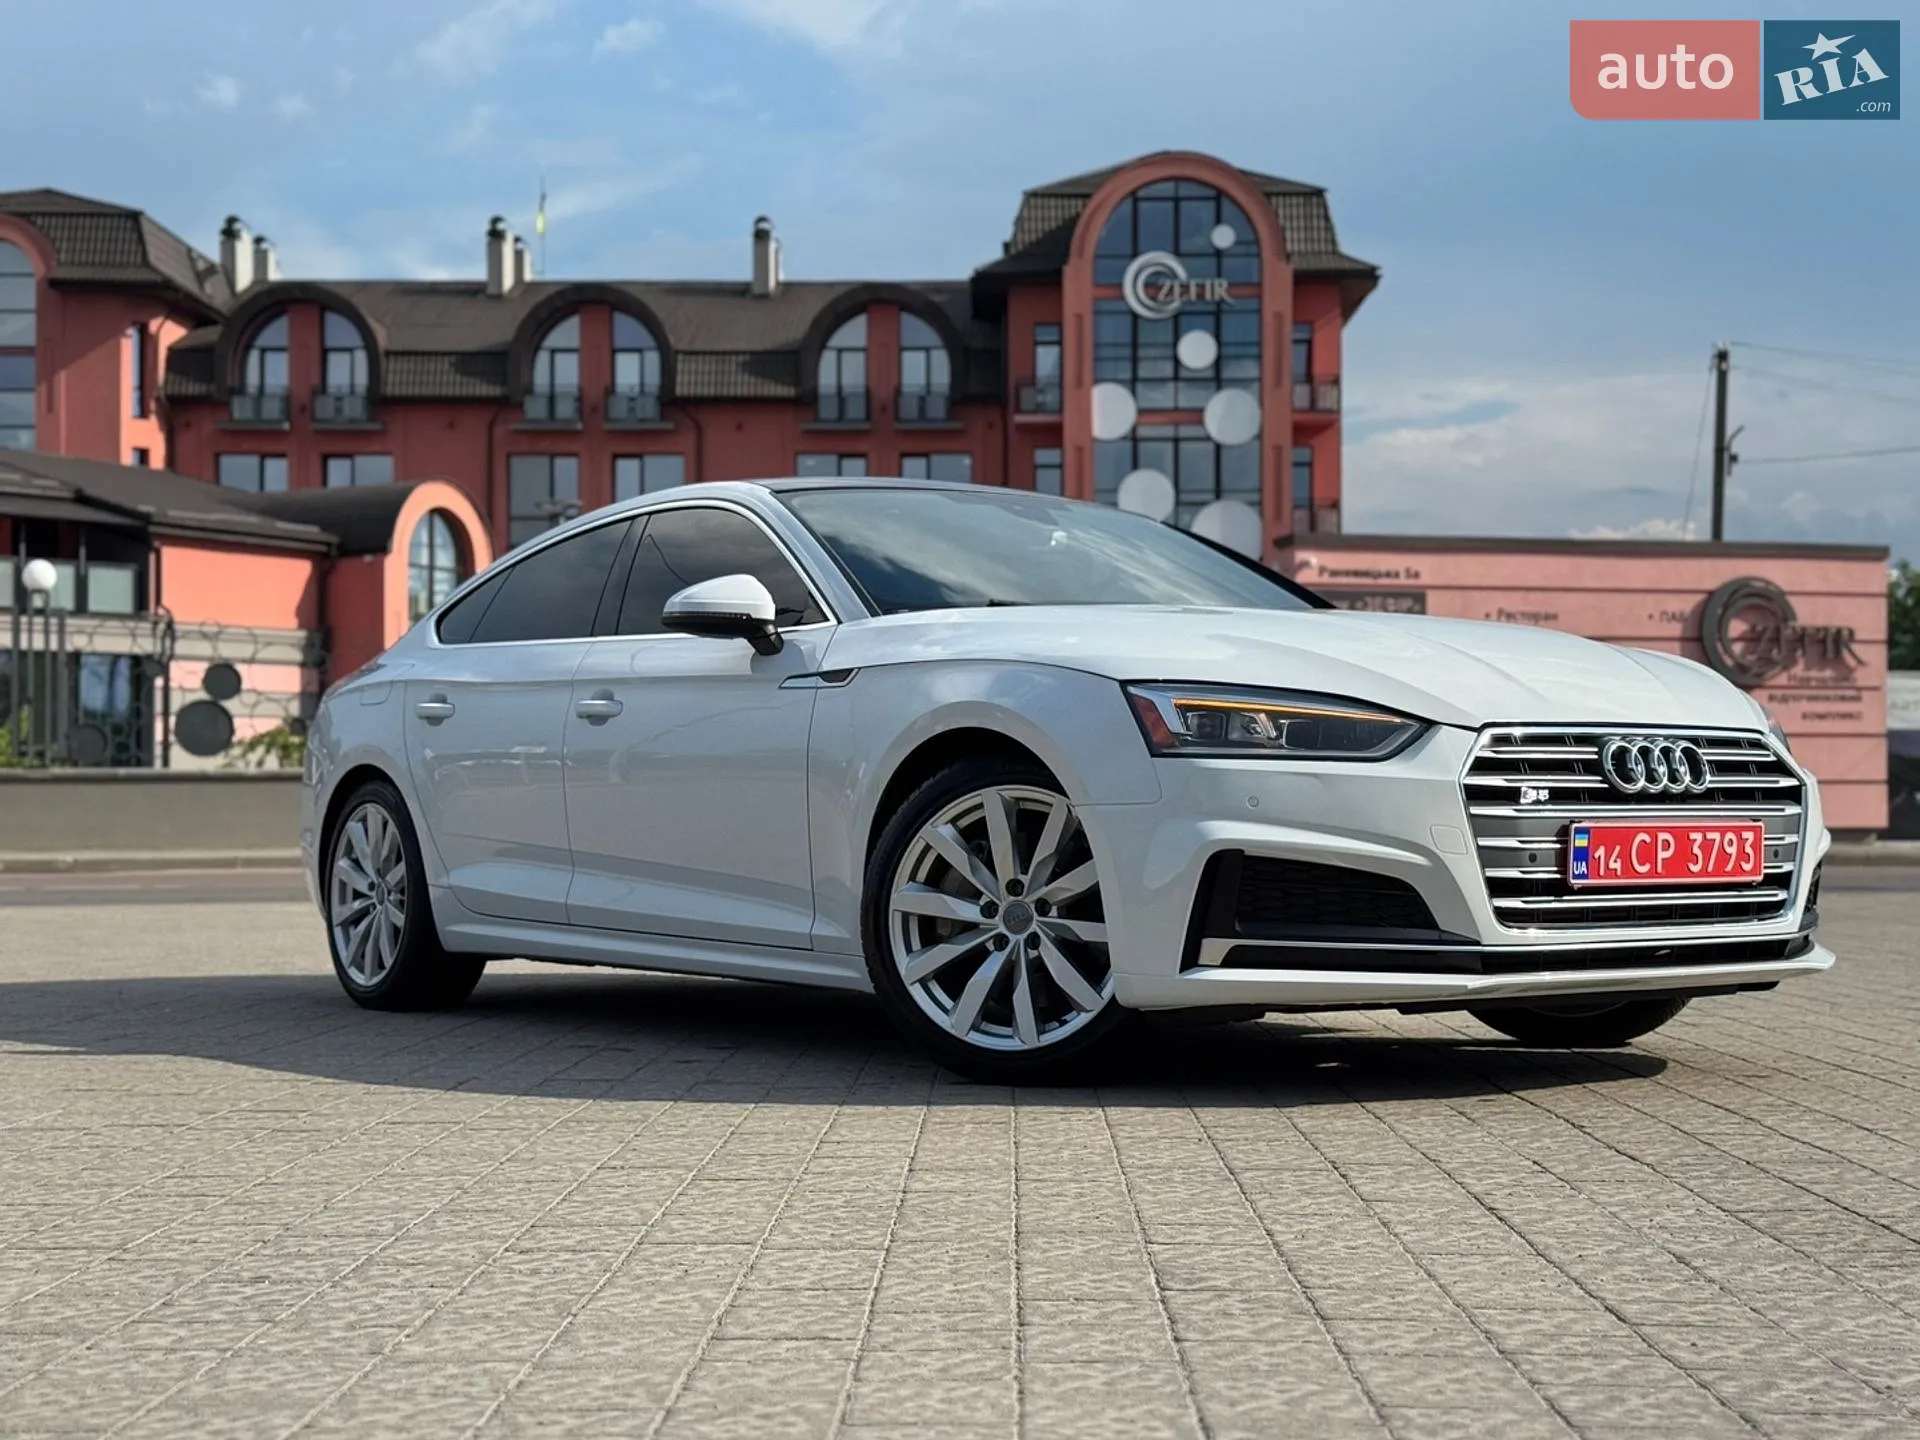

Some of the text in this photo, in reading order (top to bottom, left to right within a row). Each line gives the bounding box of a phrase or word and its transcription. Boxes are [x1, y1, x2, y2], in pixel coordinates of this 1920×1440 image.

[1496, 606, 1559, 625] Ресторан
[1593, 845, 1622, 877] 14
[1687, 831, 1755, 873] 3793
[1573, 861, 1588, 875] UA
